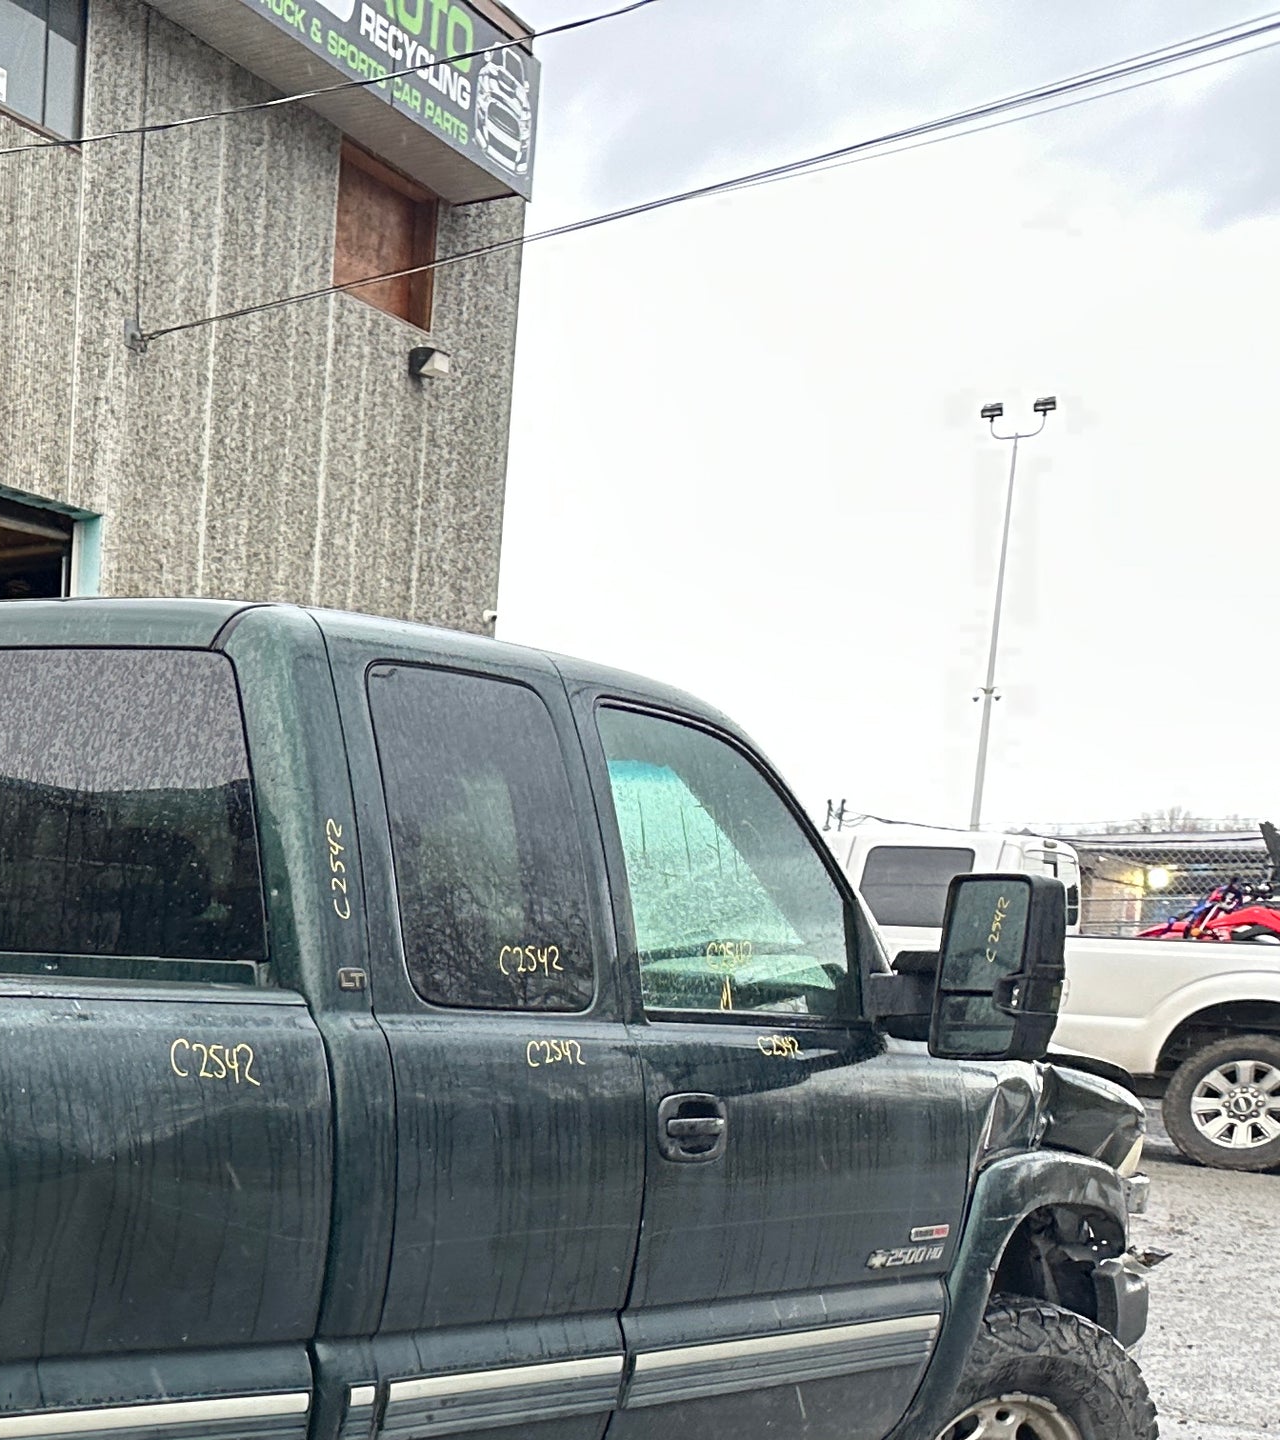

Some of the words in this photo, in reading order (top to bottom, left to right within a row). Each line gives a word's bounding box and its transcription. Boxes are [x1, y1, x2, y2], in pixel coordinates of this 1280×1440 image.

[360, 3, 471, 110] RECYCLING
[310, 17, 323, 43] &
[327, 30, 388, 90] SPORTS
[425, 102, 469, 145] PARTS
[326, 818, 351, 920] C2542
[340, 971, 365, 988] LT
[500, 945, 564, 977] C2542
[170, 1038, 261, 1086] C2542
[526, 1039, 587, 1068] C2542
